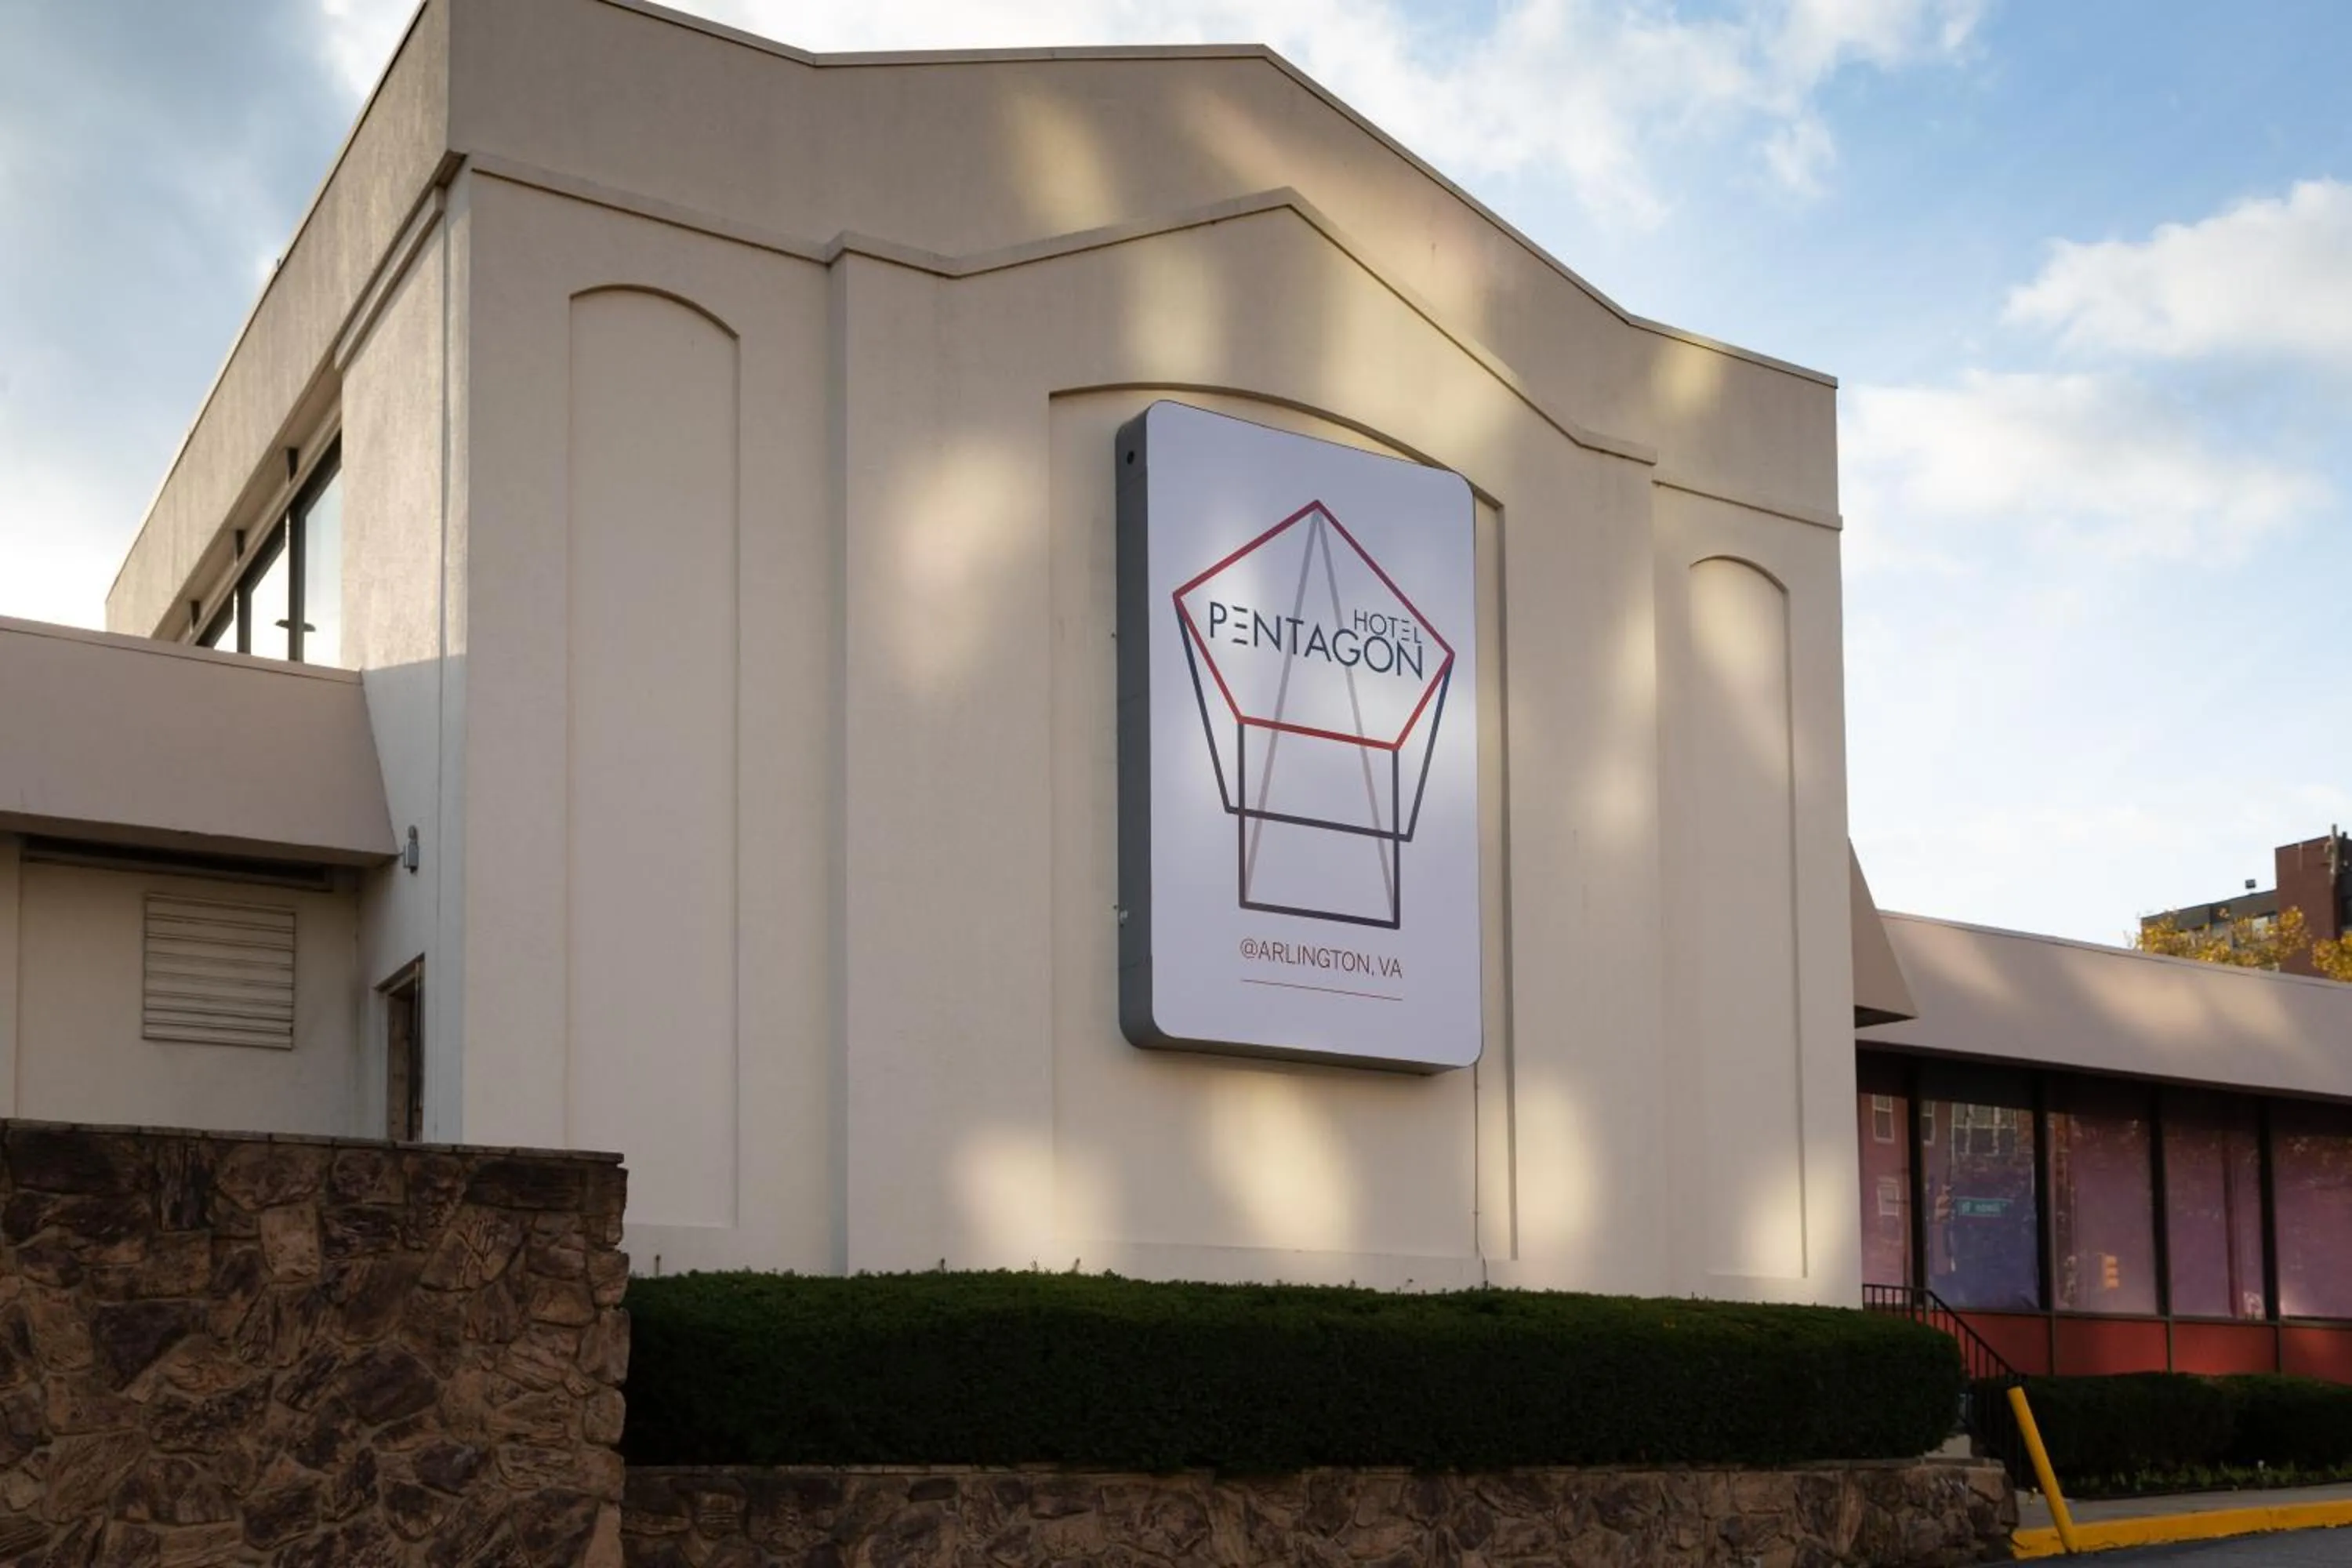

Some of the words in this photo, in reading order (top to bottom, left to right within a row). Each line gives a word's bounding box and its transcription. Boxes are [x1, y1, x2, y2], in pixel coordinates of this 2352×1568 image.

[1210, 602, 1423, 680] PENTAGON
[1354, 609, 1421, 644] HOTEL
[1378, 956, 1403, 979] VA
